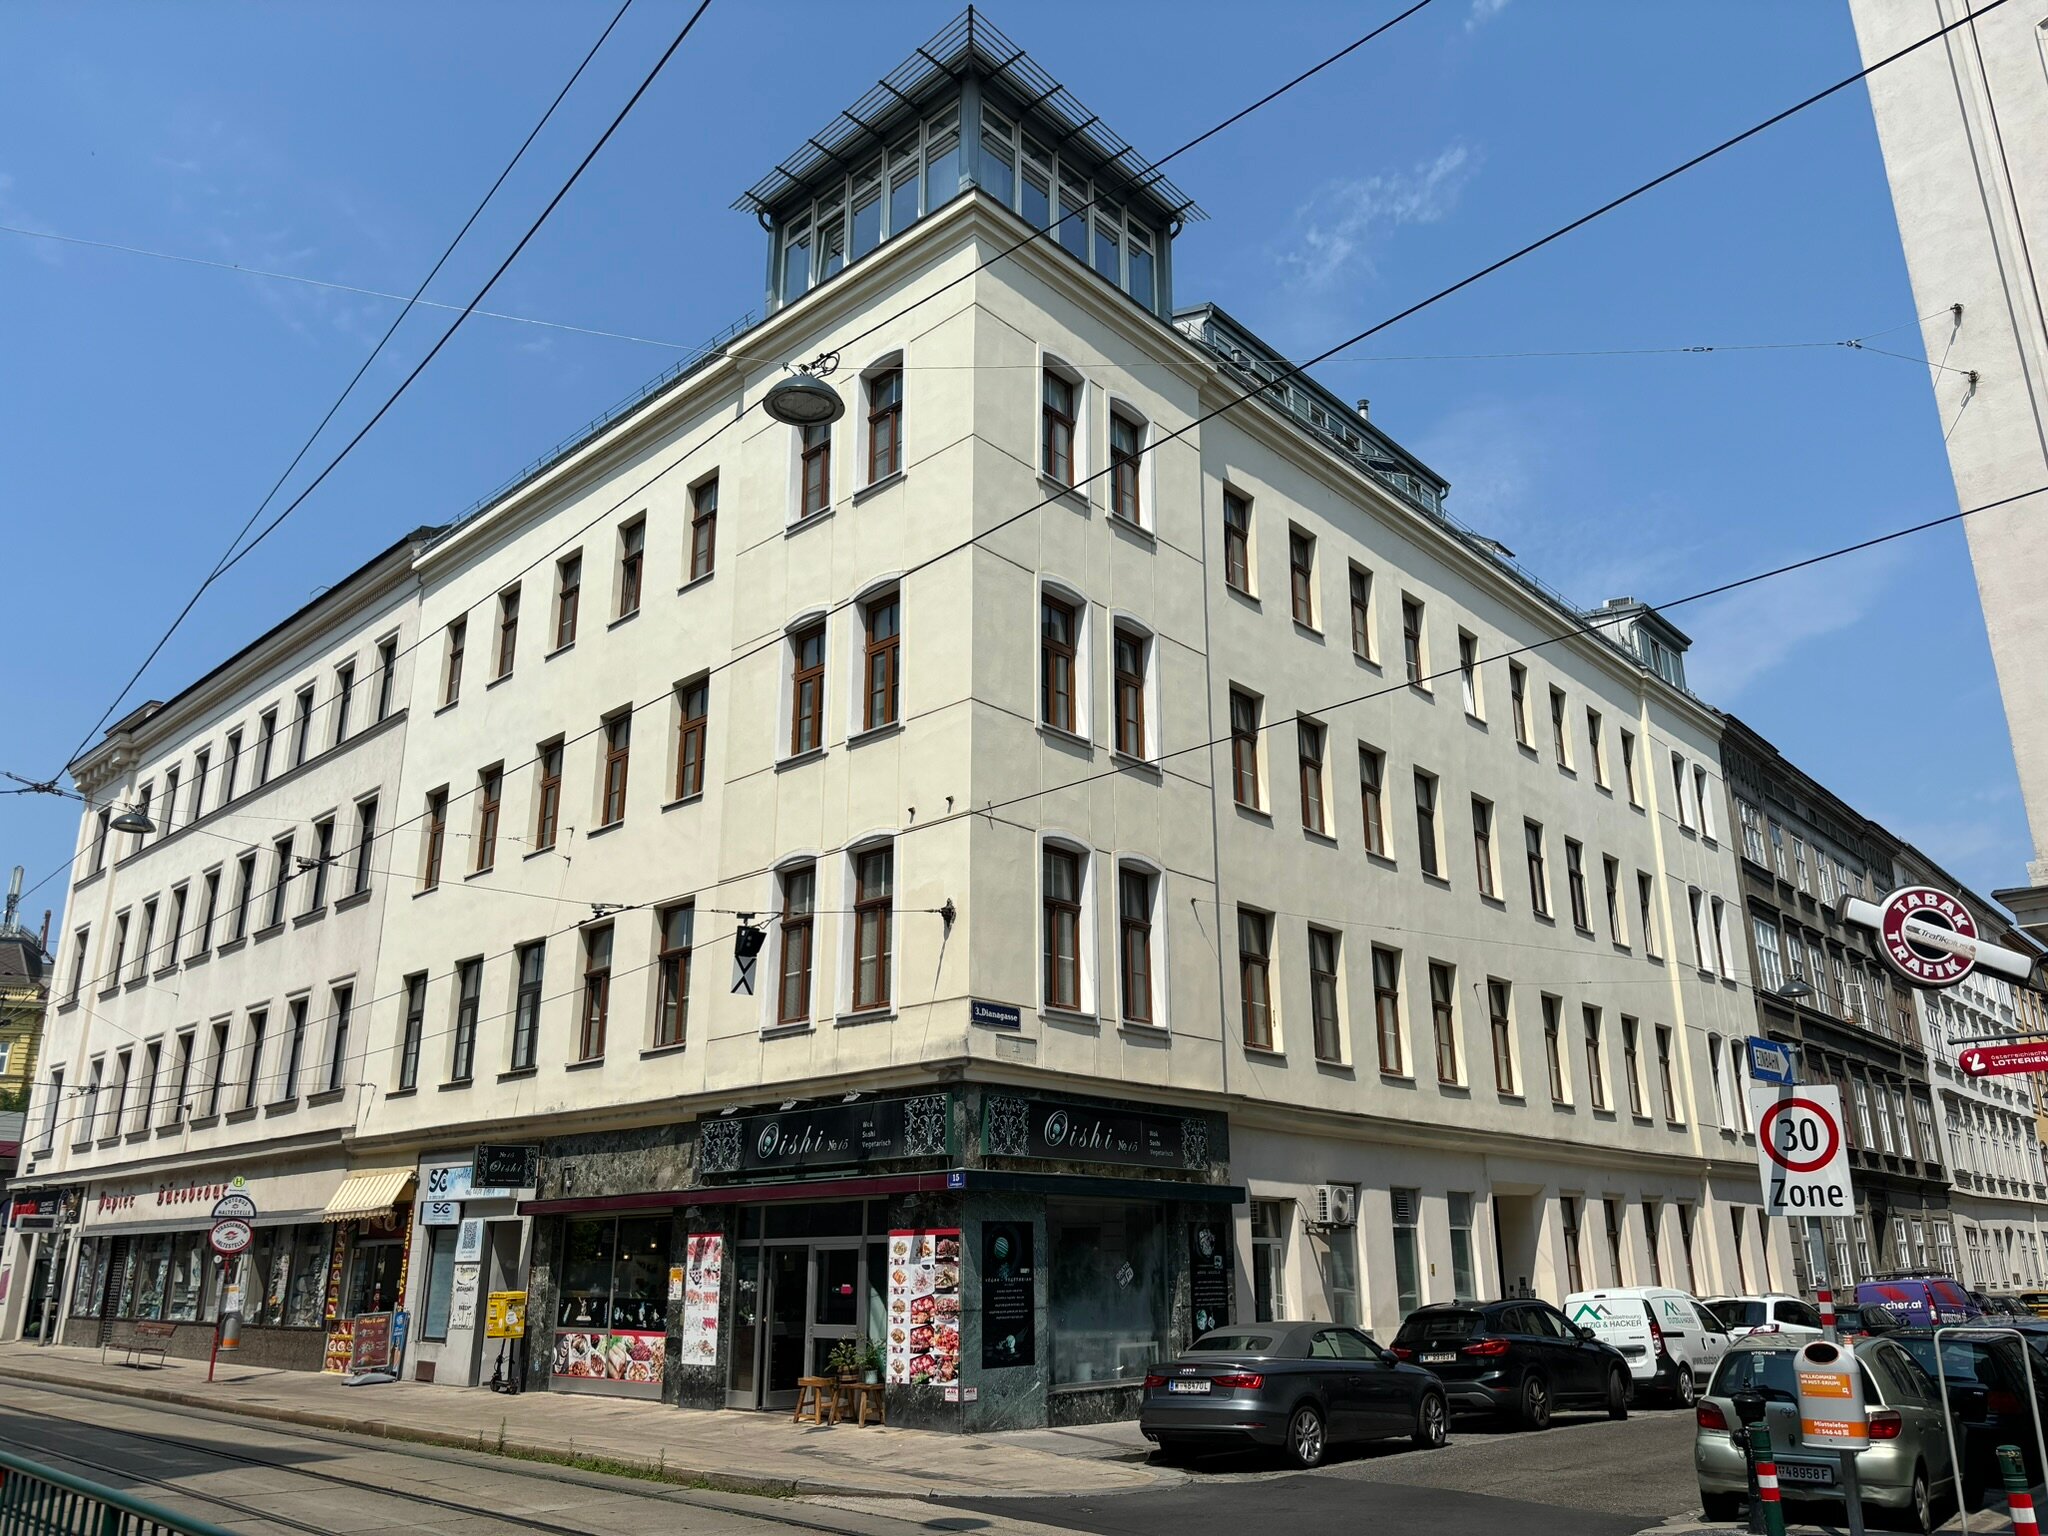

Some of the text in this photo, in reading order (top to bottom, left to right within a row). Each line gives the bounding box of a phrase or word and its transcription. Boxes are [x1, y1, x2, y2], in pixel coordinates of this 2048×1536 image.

[1893, 893, 1970, 929] TABAK
[1887, 930, 1962, 978] TRAFIK
[1992, 1056, 2048, 1067] LOTTERIEN
[862, 1130, 876, 1138] Sushi
[1044, 1110, 1113, 1150] Oishi
[1779, 1118, 1819, 1152] 30
[758, 1122, 824, 1159] Oishi
[490, 1160, 522, 1173] Oishi
[952, 1173, 960, 1182] 15
[1771, 1179, 1844, 1208] Zone
[98, 1187, 136, 1215] Papier
[224, 1197, 248, 1207] AUTOBUS
[215, 1222, 248, 1235] STRASSENBAHN
[215, 1238, 245, 1249] HALTESTELLE
[1576, 1319, 1601, 1329] TUTZIG
[1609, 1319, 1642, 1328] HACKER
[1814, 1421, 1849, 1429] Misttelefon
